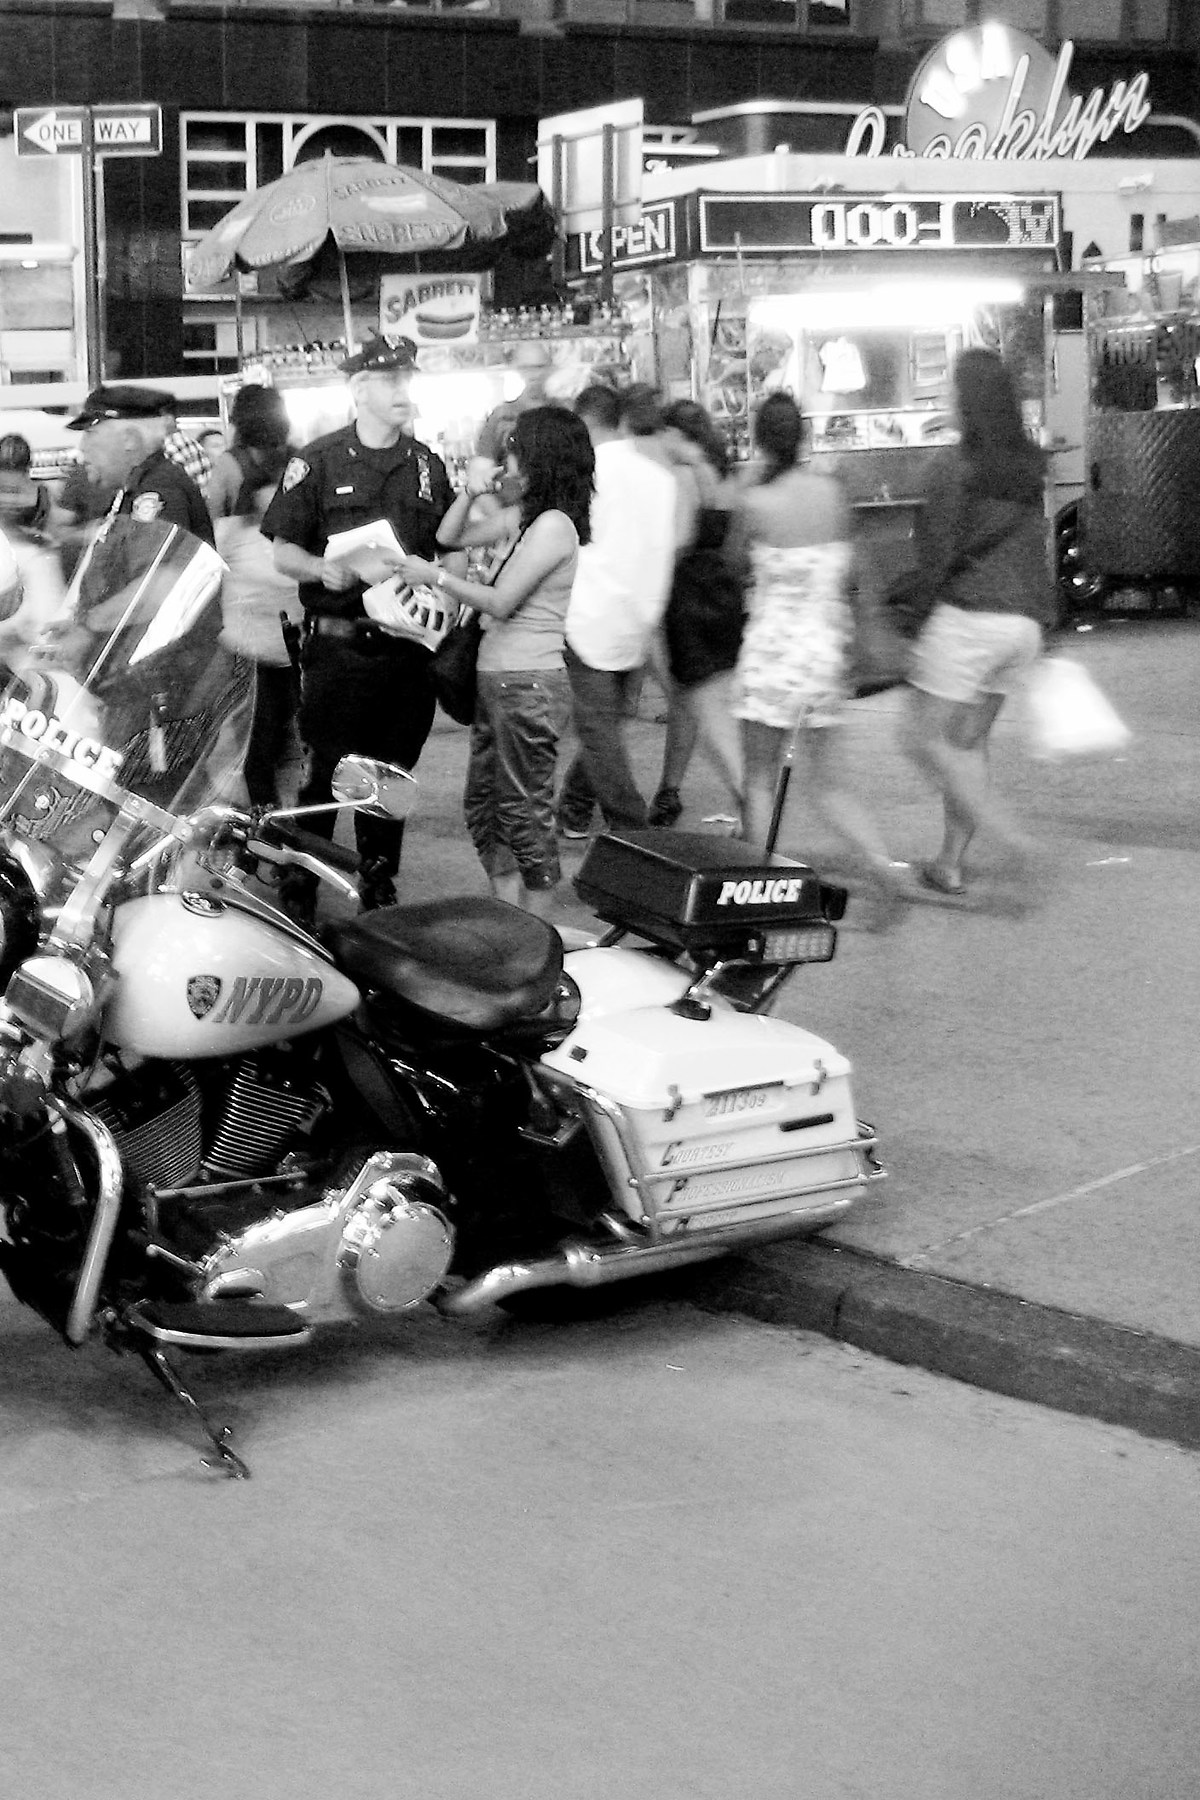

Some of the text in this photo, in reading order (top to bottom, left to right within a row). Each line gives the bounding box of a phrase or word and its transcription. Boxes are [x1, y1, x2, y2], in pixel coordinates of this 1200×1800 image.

[39, 121, 140, 141] ONE WAY
[385, 278, 477, 324] SABRETT
[717, 879, 803, 905] POLICE
[211, 976, 323, 1024] NYPD
